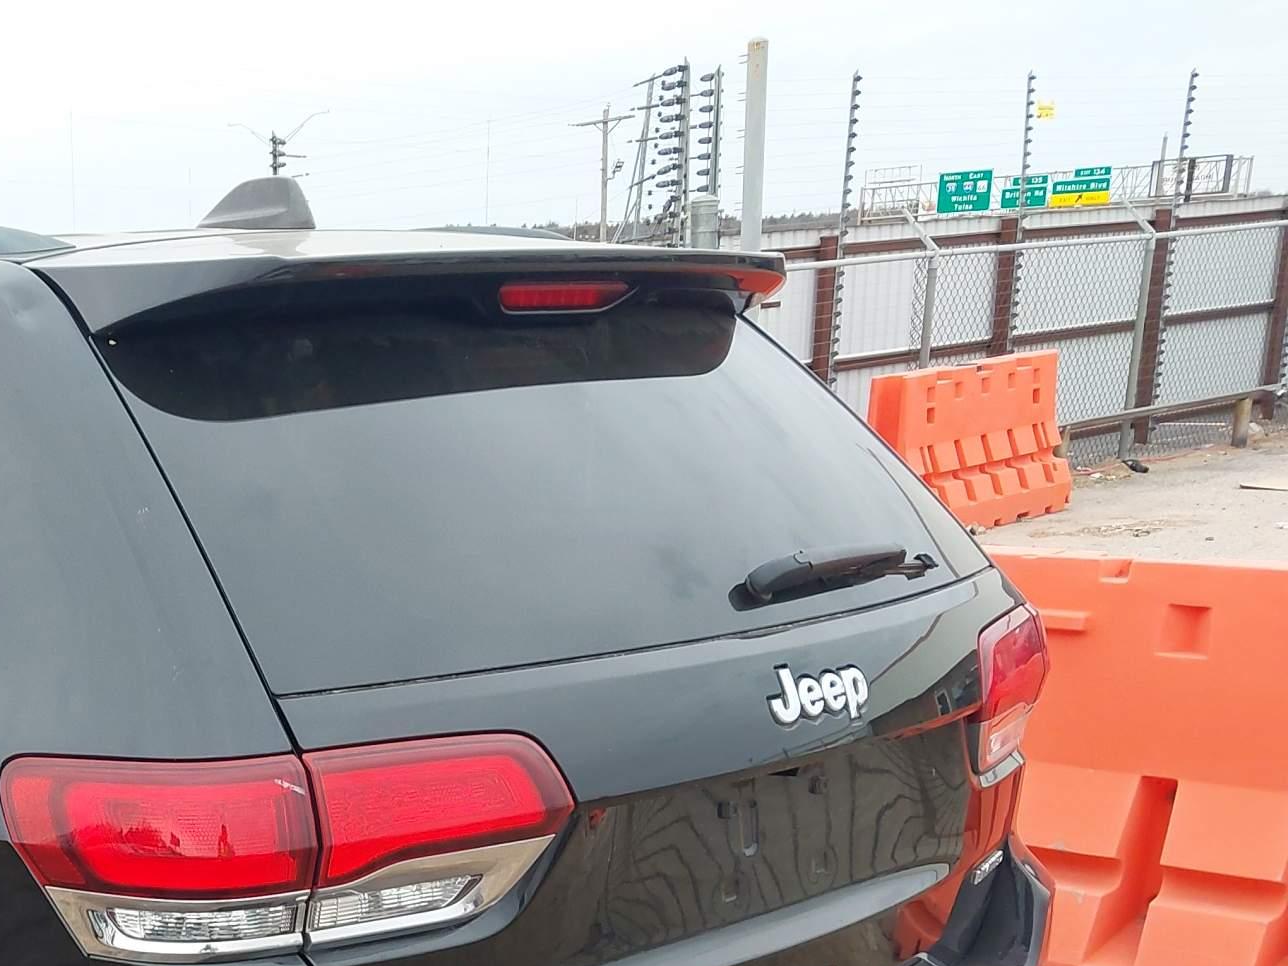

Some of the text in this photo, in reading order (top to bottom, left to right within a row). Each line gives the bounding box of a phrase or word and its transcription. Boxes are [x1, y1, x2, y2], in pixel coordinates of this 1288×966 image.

[1056, 181, 1108, 191] Wilshire Blvd
[1034, 189, 1044, 197] Rd
[951, 194, 978, 203] Wichita
[767, 664, 869, 724] Jeep
